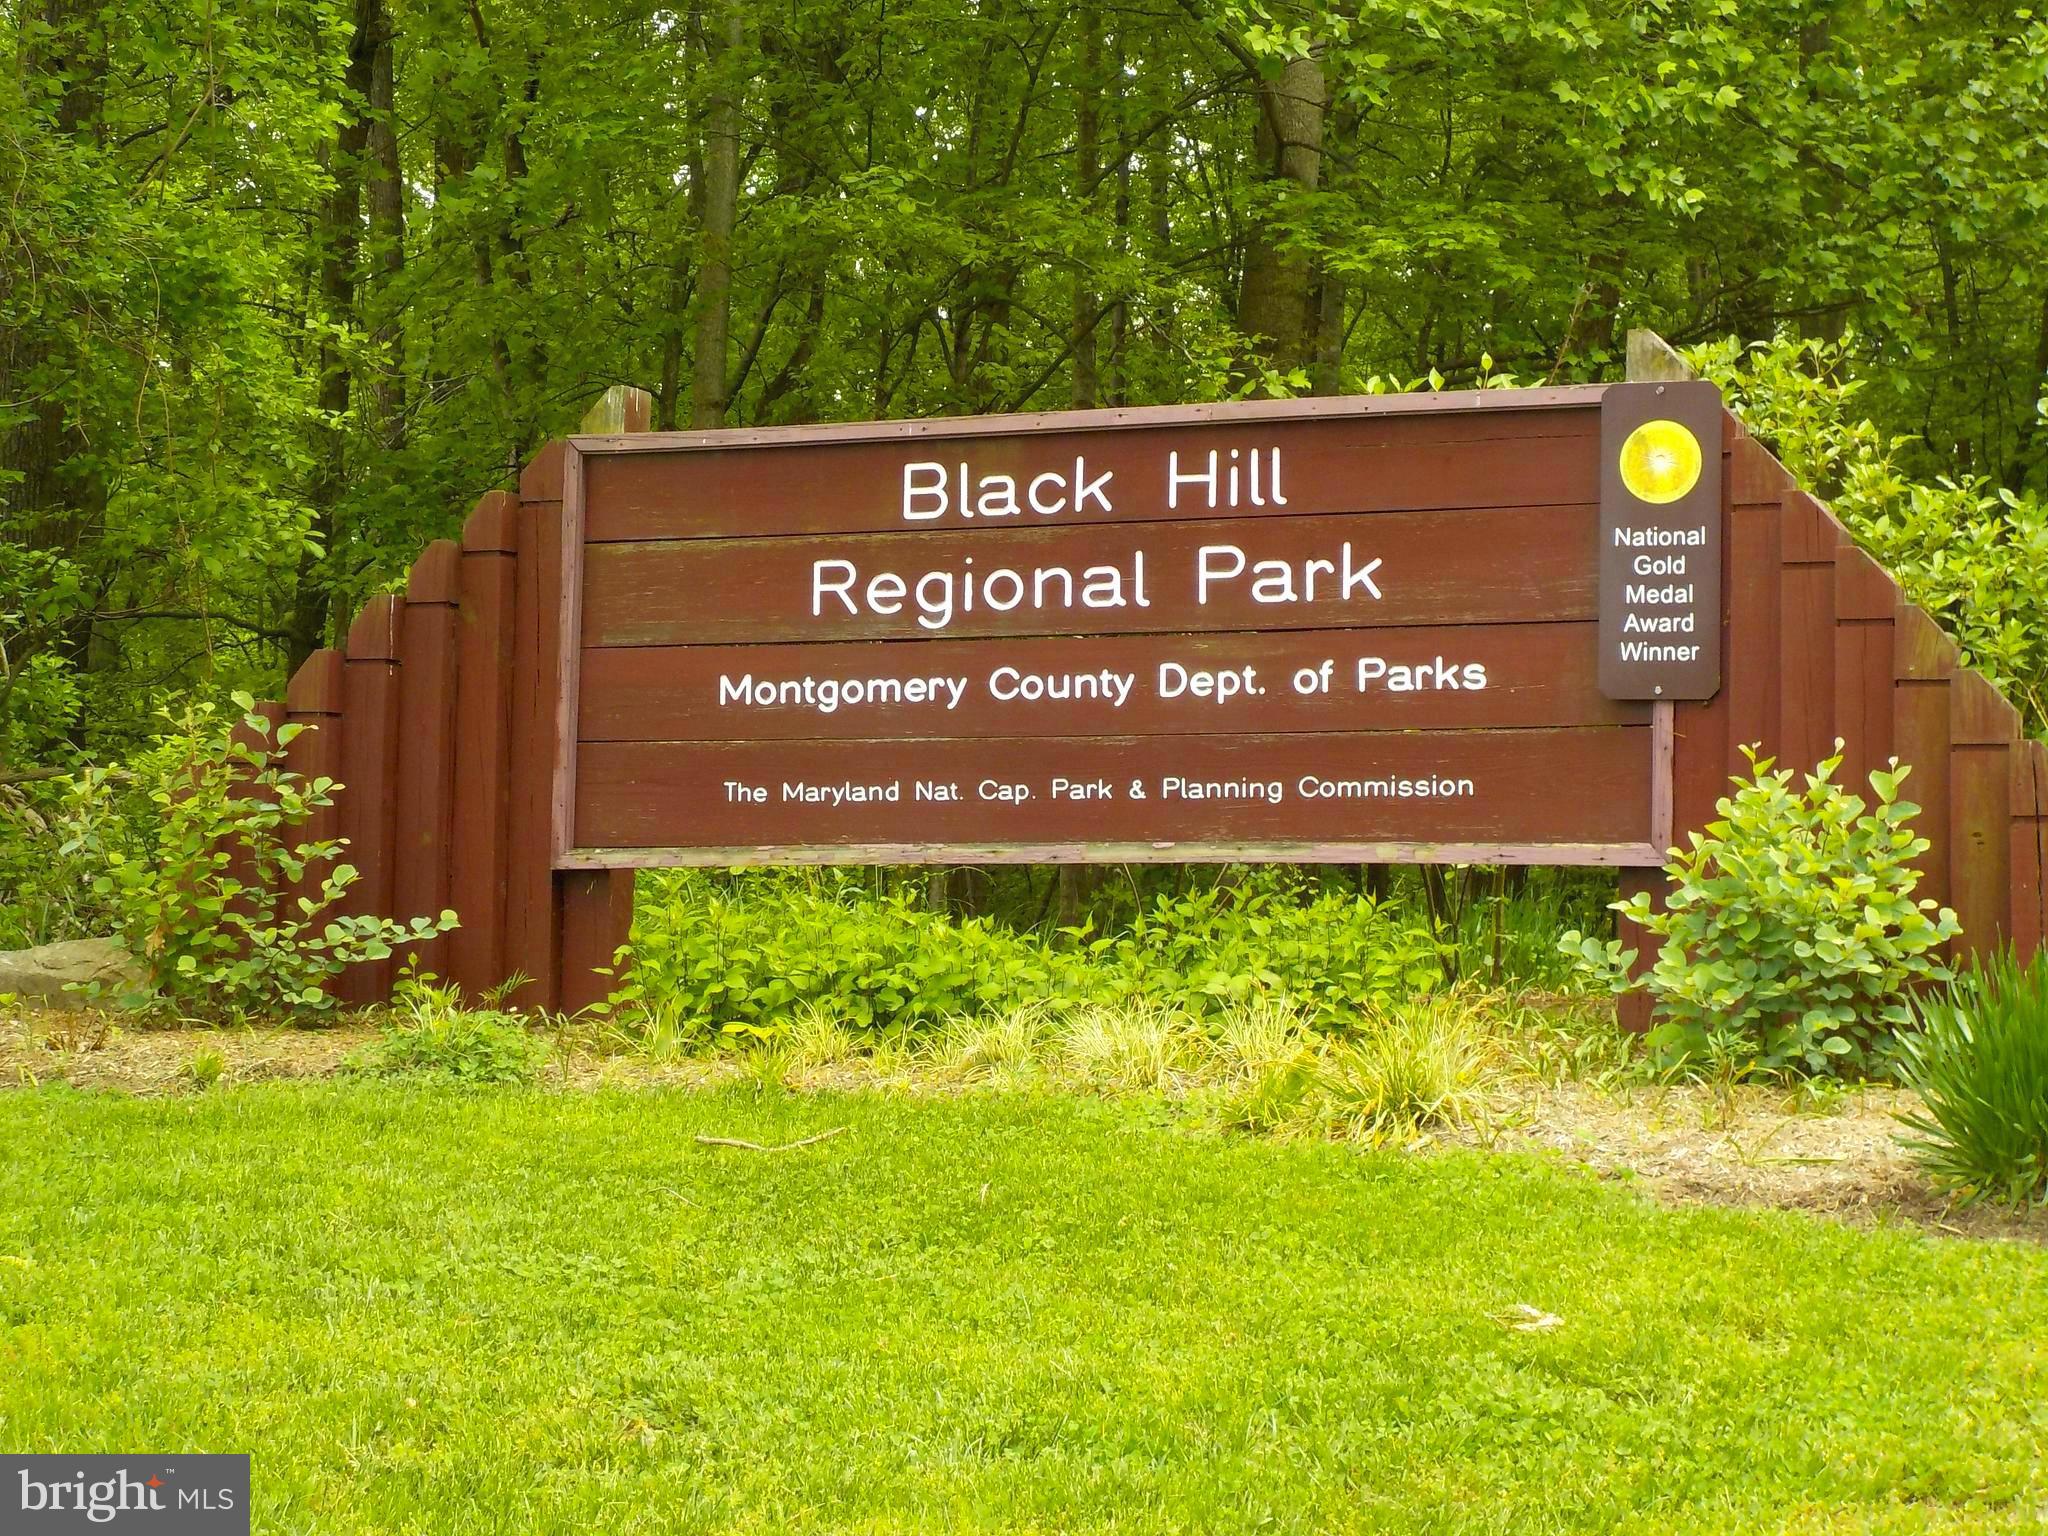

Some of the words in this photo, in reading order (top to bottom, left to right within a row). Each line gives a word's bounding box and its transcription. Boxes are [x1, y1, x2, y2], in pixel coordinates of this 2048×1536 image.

[902, 456, 1114, 521] Black
[1168, 446, 1288, 509] Hill
[1612, 525, 1706, 548] National
[1632, 554, 1686, 576] Gold
[812, 550, 1151, 630] Regional
[1198, 541, 1383, 605] Park
[1625, 583, 1694, 604] Medal
[1623, 612, 1695, 633] Award
[1620, 640, 1701, 662] Winner
[719, 673, 968, 714] Montgomery
[988, 666, 1135, 707] County
[1158, 662, 1266, 705] Dept.
[1292, 659, 1334, 695] of
[1356, 655, 1488, 693] Parks
[723, 781, 768, 803] The
[782, 780, 900, 807] Maryland
[915, 780, 964, 802] Nat.
[978, 779, 1036, 806] Cap.
[1051, 778, 1113, 800] Park
[1128, 779, 1147, 800] &
[1162, 776, 1283, 804] Planning
[1298, 774, 1474, 798] Commission
